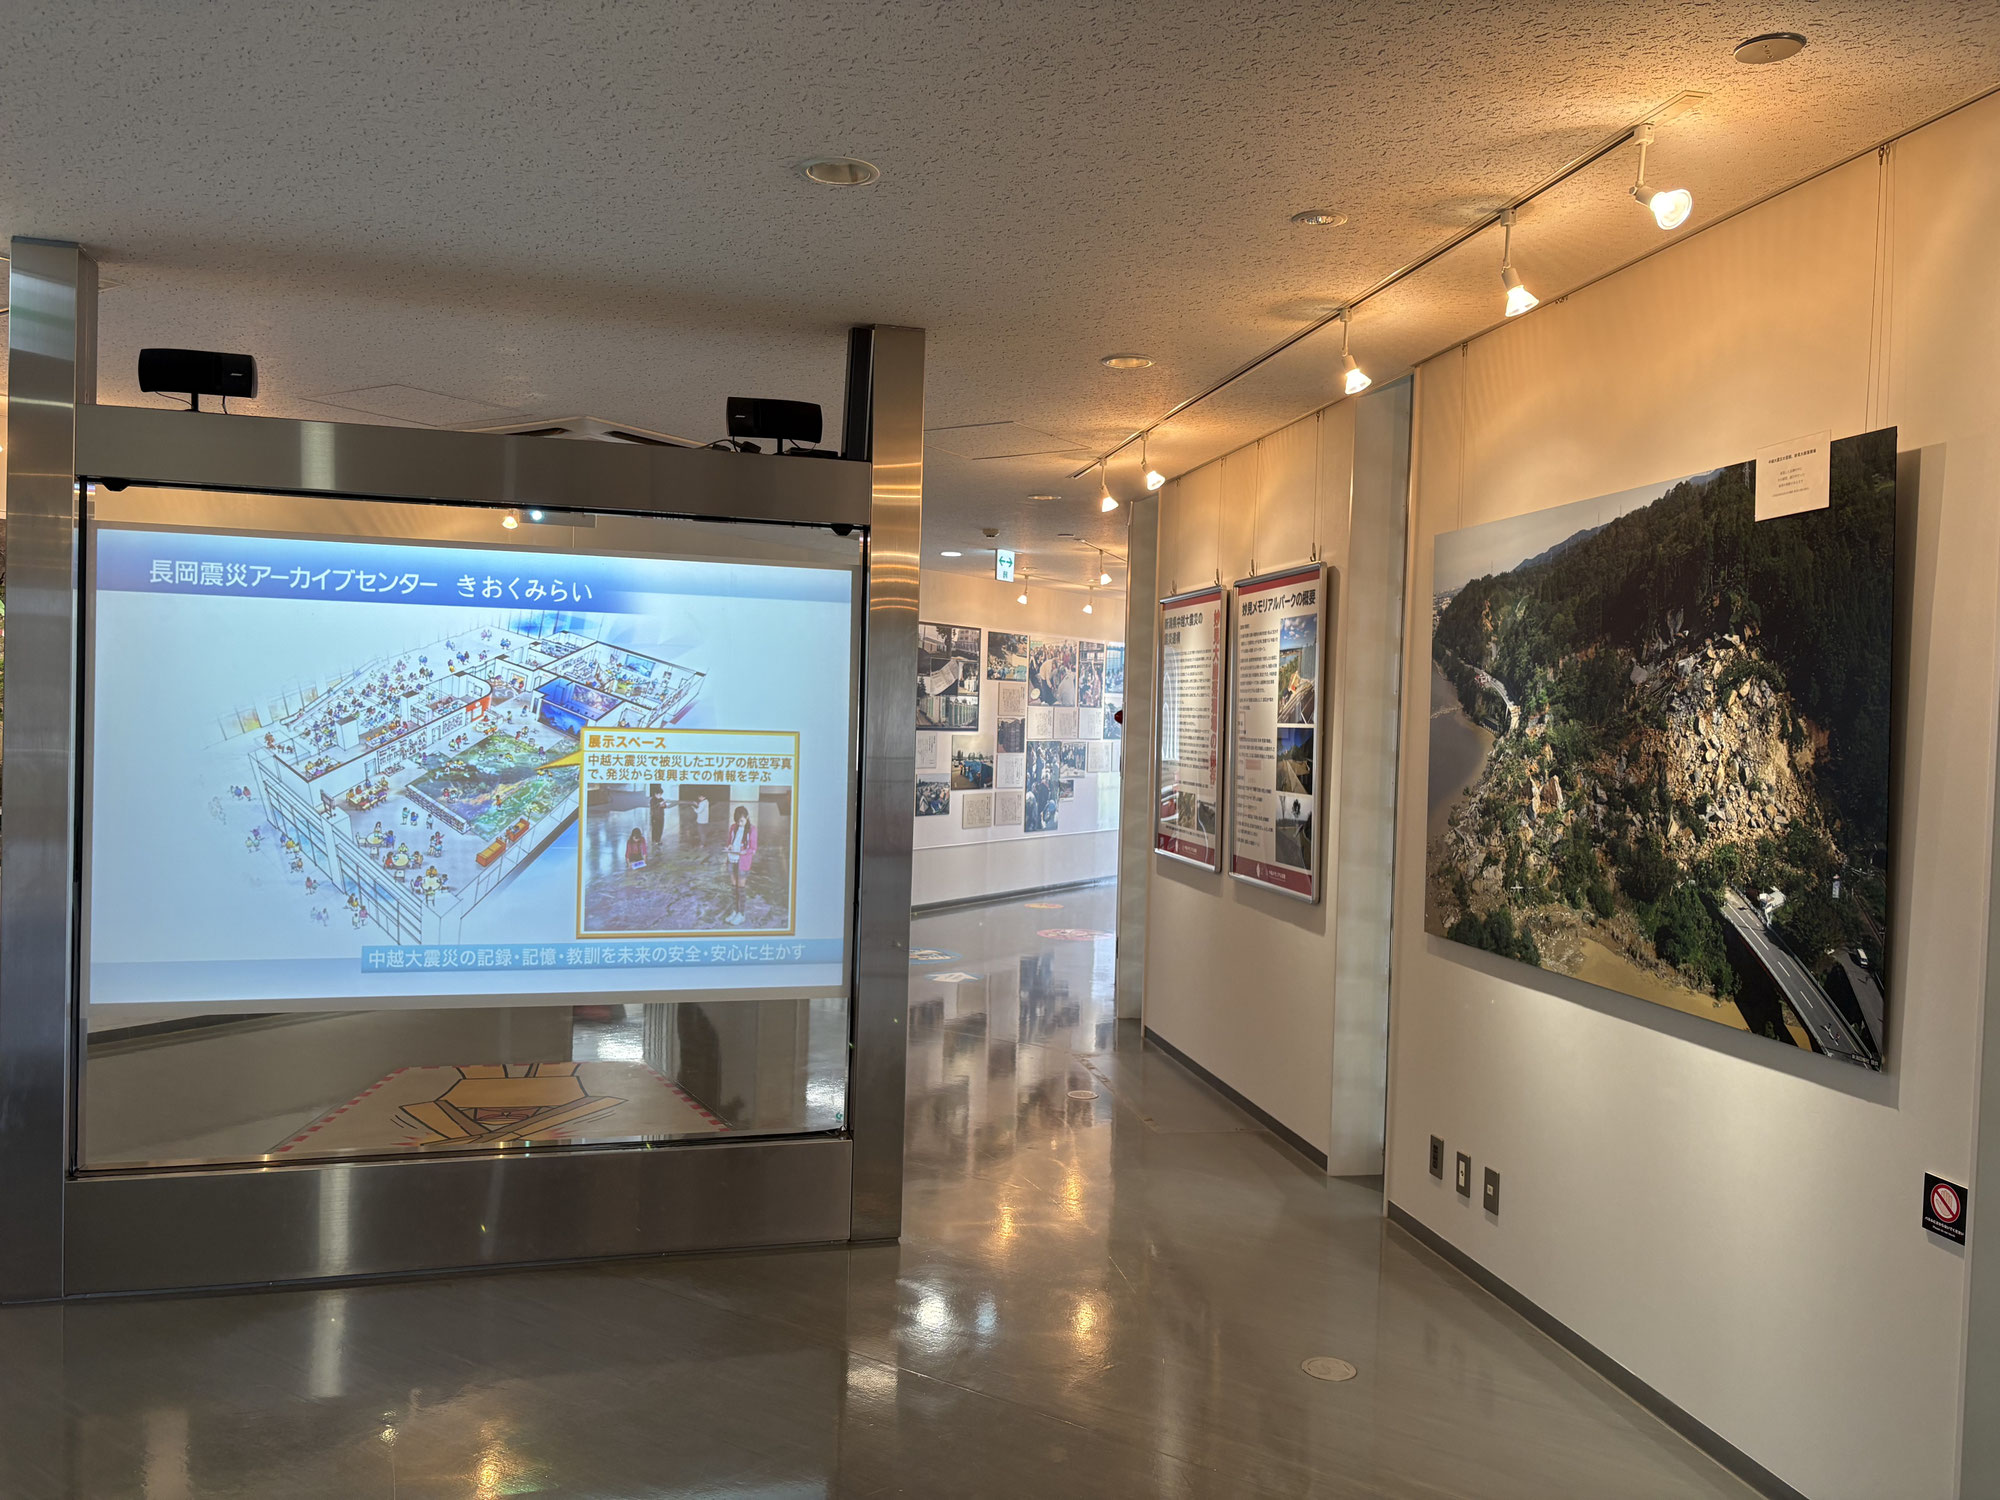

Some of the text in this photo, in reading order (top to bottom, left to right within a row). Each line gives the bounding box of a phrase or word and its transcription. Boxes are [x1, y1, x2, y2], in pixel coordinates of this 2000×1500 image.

[149, 559, 593, 602] 長岡震災アーカイブセンター きおくみらい
[1241, 589, 1316, 617] 妙見メモリアルパークの概要
[588, 734, 667, 749] 展示スペース
[588, 754, 792, 770] 中越大震災で被災したエリアの航空写真
[588, 768, 772, 783] で、発災から復興までの情報を学ぶ
[368, 943, 807, 969] 中越大震災の記録・記憶・教訓を未来の安全・安心に生かす
